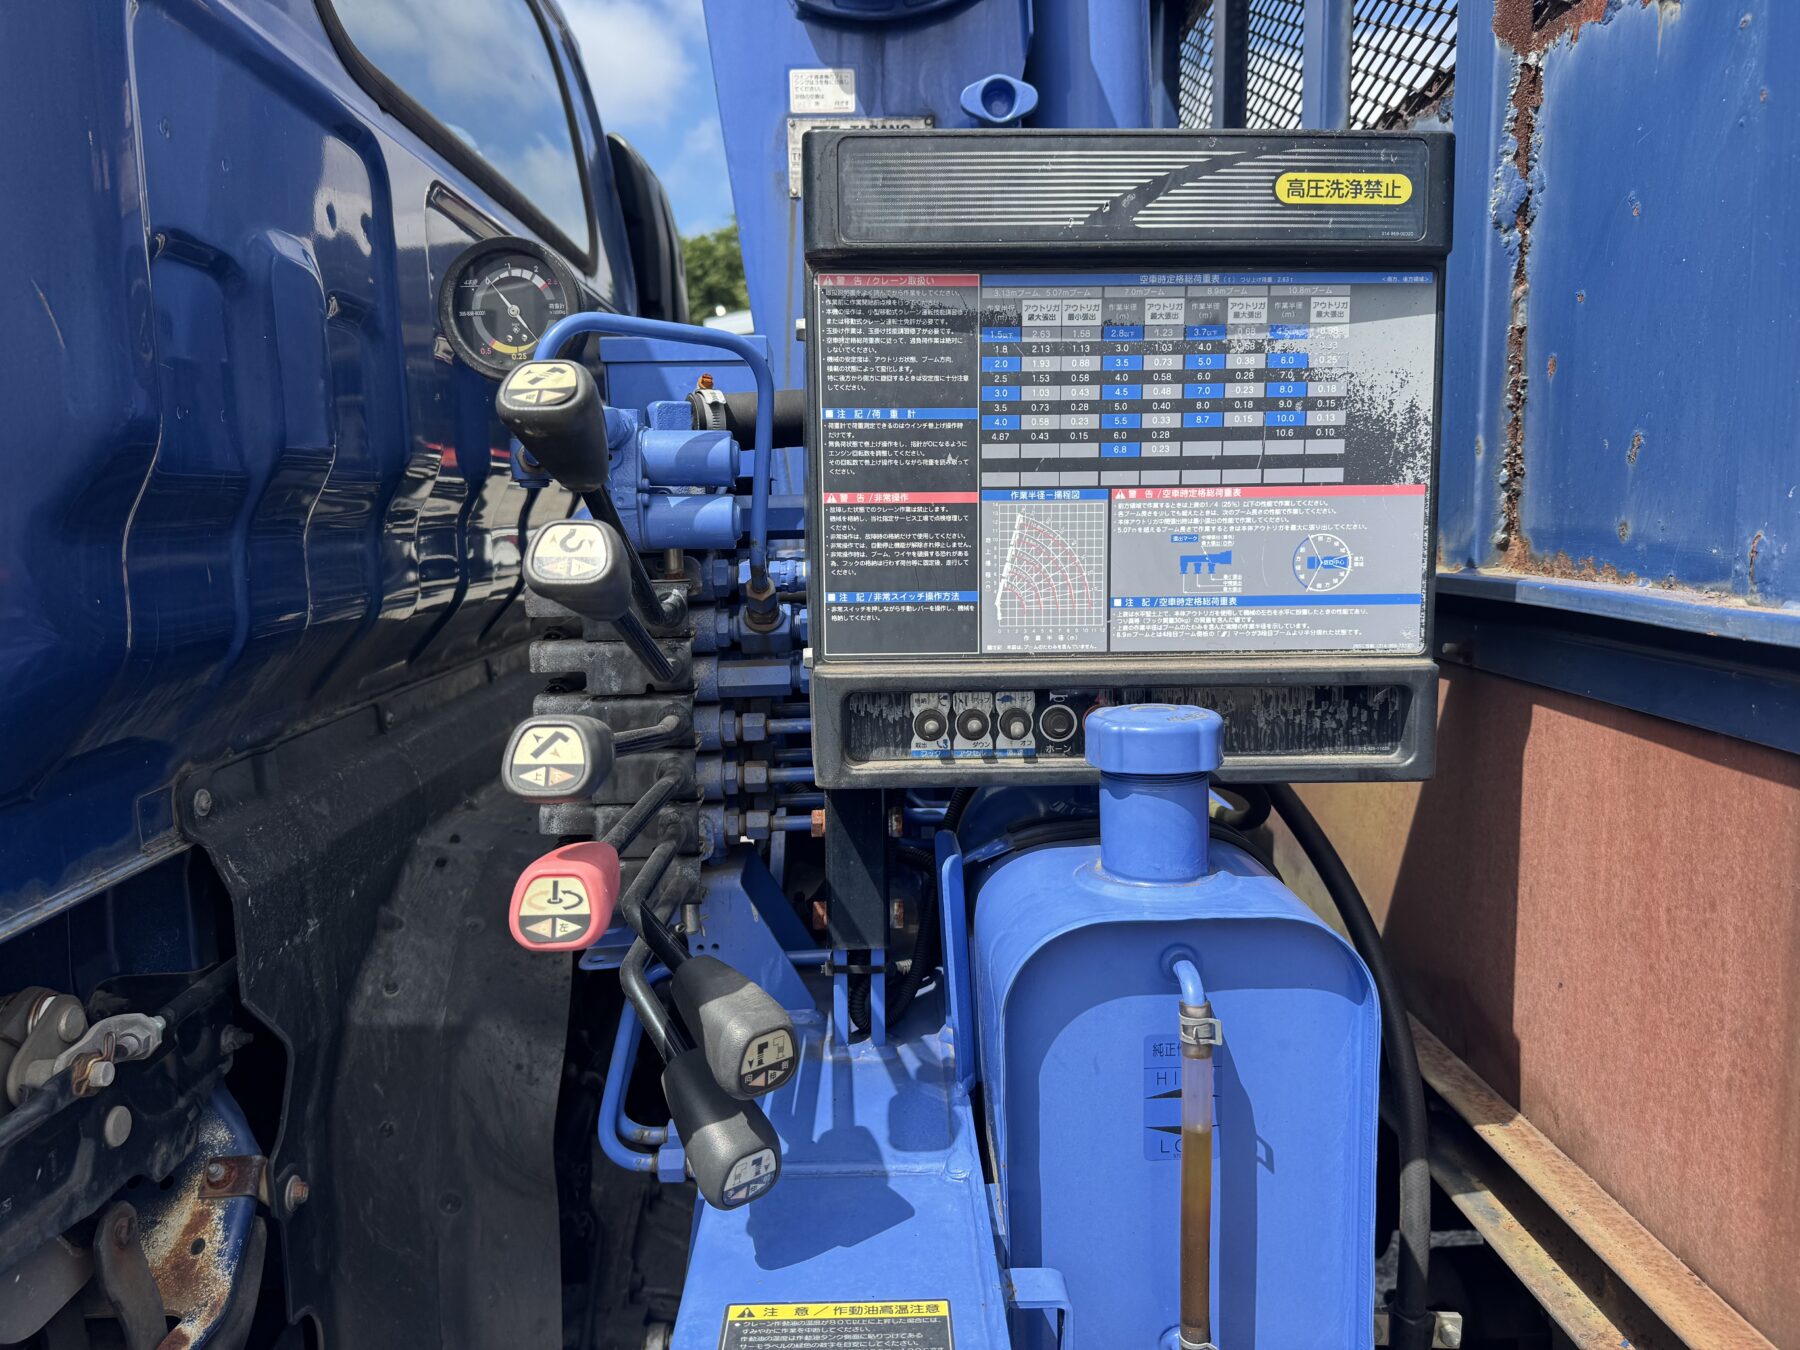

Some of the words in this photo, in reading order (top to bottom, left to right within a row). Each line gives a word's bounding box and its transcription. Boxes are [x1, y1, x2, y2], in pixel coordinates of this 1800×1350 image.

[1286, 179, 1401, 199] 高圧洗浄禁止
[1140, 275, 1220, 284] 空車時定格総荷重表
[1207, 287, 1247, 295] 8.9mブーム
[1289, 286, 1332, 294] 10.8mブーム
[1024, 304, 1059, 312] アウトリガ
[1230, 302, 1265, 310] アウトリガ
[1032, 330, 1050, 339] 2.63
[1072, 330, 1091, 339] 1.58
[1154, 328, 1173, 337] 1.23
[995, 345, 1008, 353] 1.8
[1032, 345, 1050, 353] 2.13
[1072, 345, 1090, 353] 1.13
[1116, 343, 1129, 352] 3.0
[1154, 343, 1173, 352] 1.03
[1198, 342, 1211, 351] 4.0
[995, 359, 1008, 368] 2.0
[1031, 359, 1050, 368] 1.93
[1071, 359, 1090, 368] 0.88
[1115, 358, 1129, 367] 3.5
[1153, 358, 1172, 366] 0.73
[1198, 357, 1211, 366] 5.0
[1236, 357, 1255, 365] 0.38
[1281, 356, 1294, 364] 6.0
[994, 374, 1008, 383] 2.5
[1031, 374, 1050, 383] 1.53
[1071, 373, 1090, 382] 0.58
[1115, 373, 1129, 382] 4.0
[1153, 372, 1172, 381] 0.58
[1197, 372, 1211, 381] 6.0
[1235, 371, 1254, 380] 0.28
[1280, 370, 1293, 379] 7.0
[994, 389, 1007, 397] 3.0
[1031, 388, 1050, 397] 1.03
[1071, 388, 1089, 397] 0.43
[1115, 387, 1128, 396] 4.5
[1153, 387, 1171, 396] 0.48
[1197, 386, 1210, 395] 7.0
[1235, 385, 1254, 394] 0.23
[1280, 385, 1293, 393] 8.0
[1318, 384, 1336, 393] 0.18
[994, 403, 1007, 412] 3.5
[1031, 403, 1049, 412] 0.73
[1070, 403, 1089, 411] 0.28
[1114, 402, 1128, 411] 5.0
[1152, 401, 1171, 410] 0.40
[1196, 401, 1210, 409] 8.0
[1234, 400, 1253, 408] 0.18
[1279, 399, 1292, 408] 9.0
[1317, 399, 1336, 407] 0.15
[994, 417, 1007, 426] 4.0
[1031, 417, 1049, 426] 0.58
[1070, 417, 1089, 426] 0.23
[1114, 416, 1128, 425] 5.5
[1152, 416, 1171, 424] 0.33
[1196, 415, 1209, 424] 8.7
[1234, 414, 1253, 423] 0.15
[1276, 414, 1295, 422] 10.0
[1316, 413, 1335, 422] 0.13
[991, 432, 1010, 441] 4.87
[1030, 432, 1049, 440] 0.43
[1070, 431, 1088, 440] 0.15
[1114, 431, 1127, 439] 6.0
[1152, 430, 1170, 439] 0.28
[1276, 428, 1294, 437] 10.6
[1316, 428, 1334, 437] 0.10
[1114, 445, 1127, 454] 6.8
[1151, 445, 1170, 454] 0.23
[1046, 745, 1071, 753] ホーン
[1152, 1042, 1181, 1057] 純正
